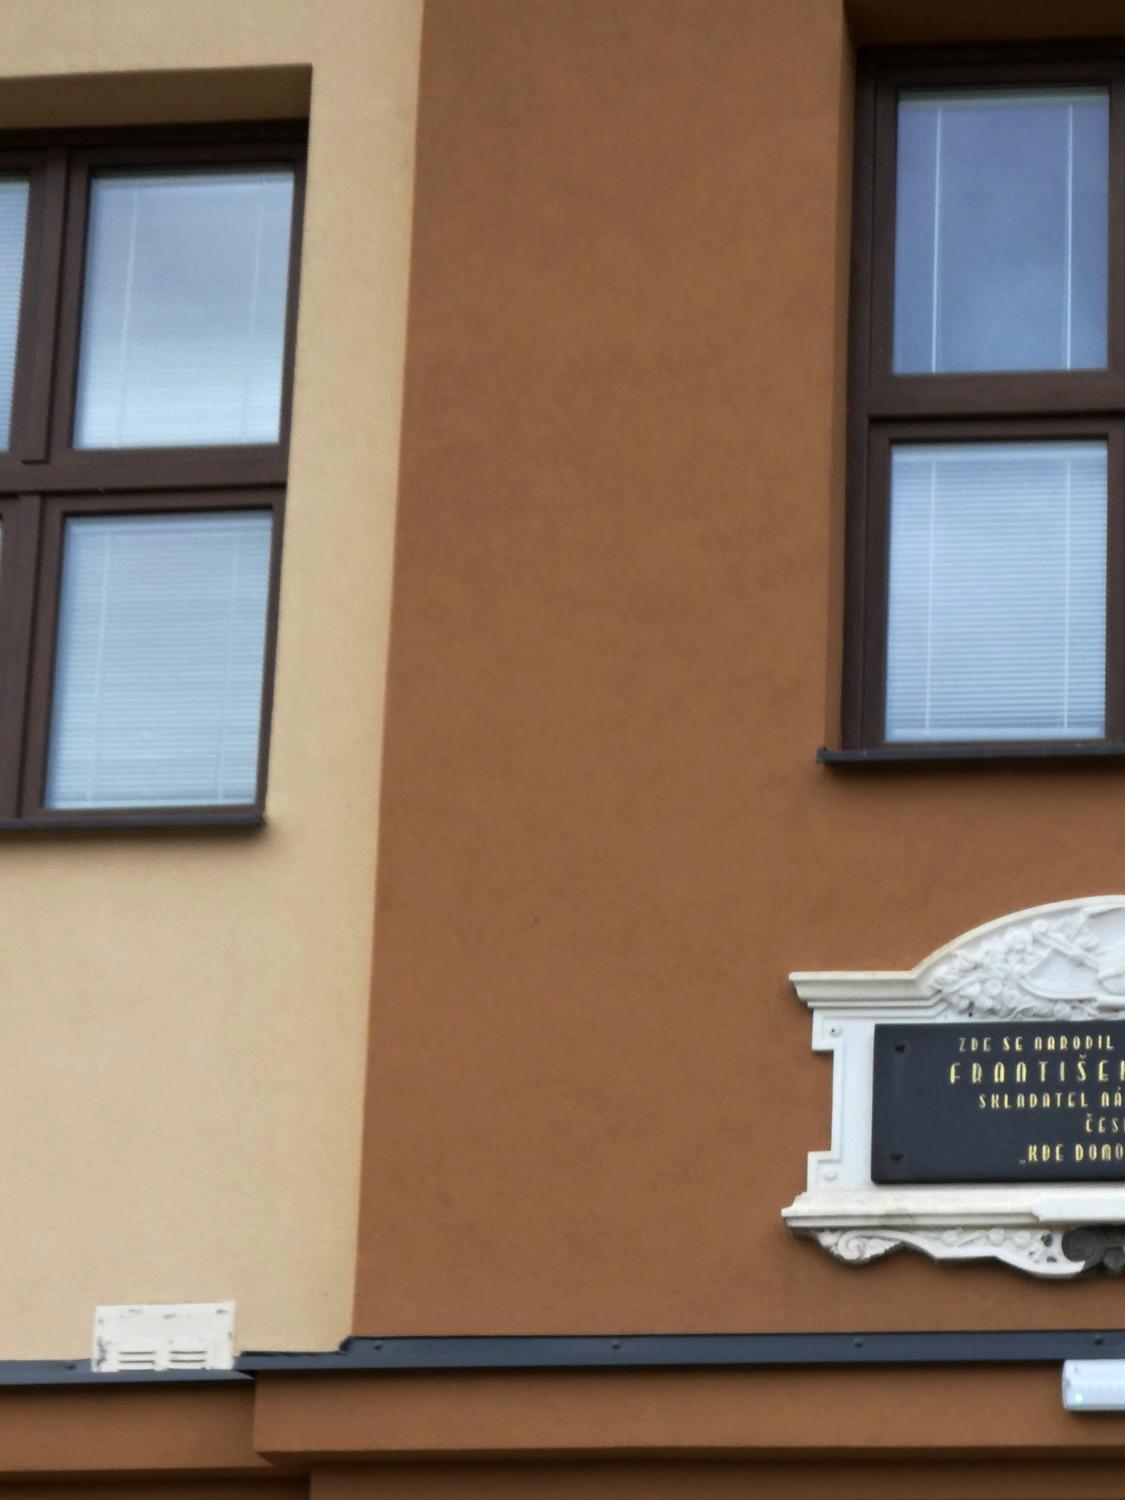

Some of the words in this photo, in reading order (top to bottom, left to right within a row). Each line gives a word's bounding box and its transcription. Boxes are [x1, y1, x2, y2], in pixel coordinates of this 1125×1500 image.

[958, 1036, 992, 1052] ZDE
[1002, 1035, 1024, 1052] SE
[1034, 1034, 1114, 1051] NARODIL
[978, 1091, 1089, 1110] SKLADATEL
